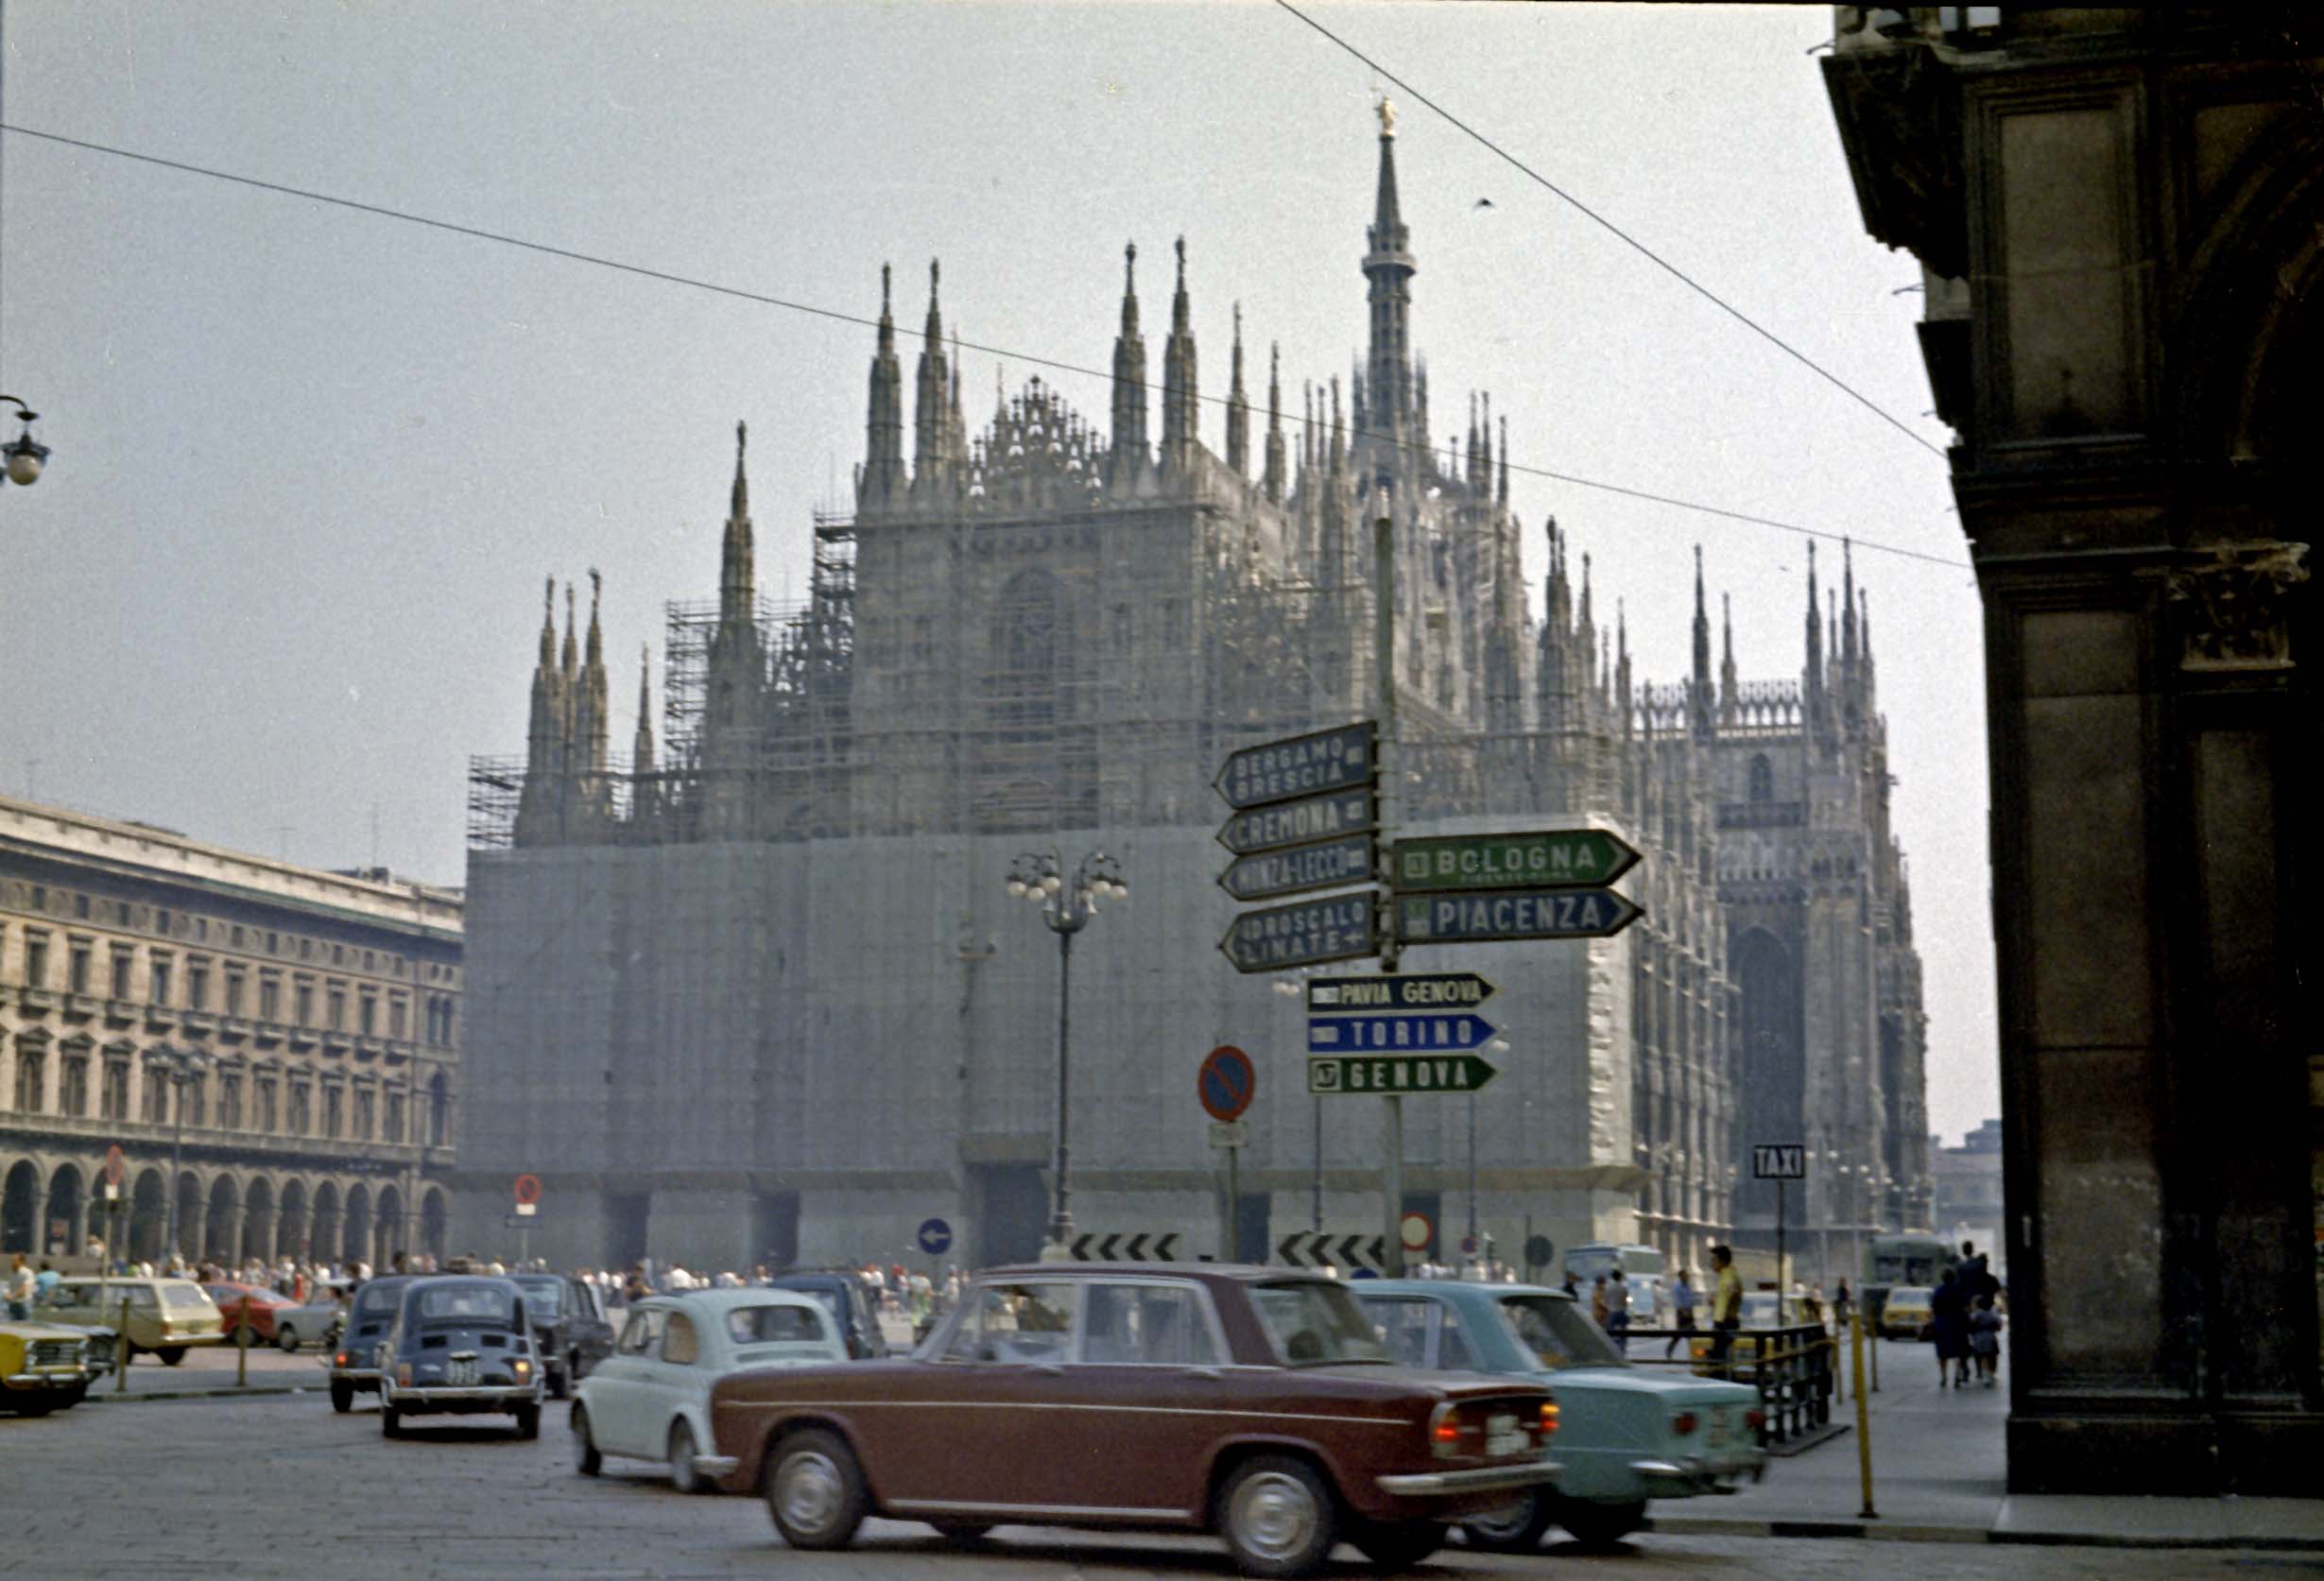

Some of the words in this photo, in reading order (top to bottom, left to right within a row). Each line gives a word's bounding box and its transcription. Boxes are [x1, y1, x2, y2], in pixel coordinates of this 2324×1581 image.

[1235, 737, 1343, 778] BERGAMO
[1235, 761, 1343, 800] BRESCIA
[1234, 800, 1340, 847] CREMONA
[1437, 843, 1596, 874] BOLOGNA
[1242, 902, 1364, 940] IDROSCALO
[1437, 896, 1602, 934] PIACENZA
[1243, 930, 1339, 964] LINATE
[1341, 983, 1392, 1005] PAVIA
[1402, 980, 1483, 1004] GENOVA
[1351, 1020, 1472, 1047] TORINO
[1350, 1059, 1469, 1088] GENOVA
[1755, 1148, 1801, 1176] TAXI
